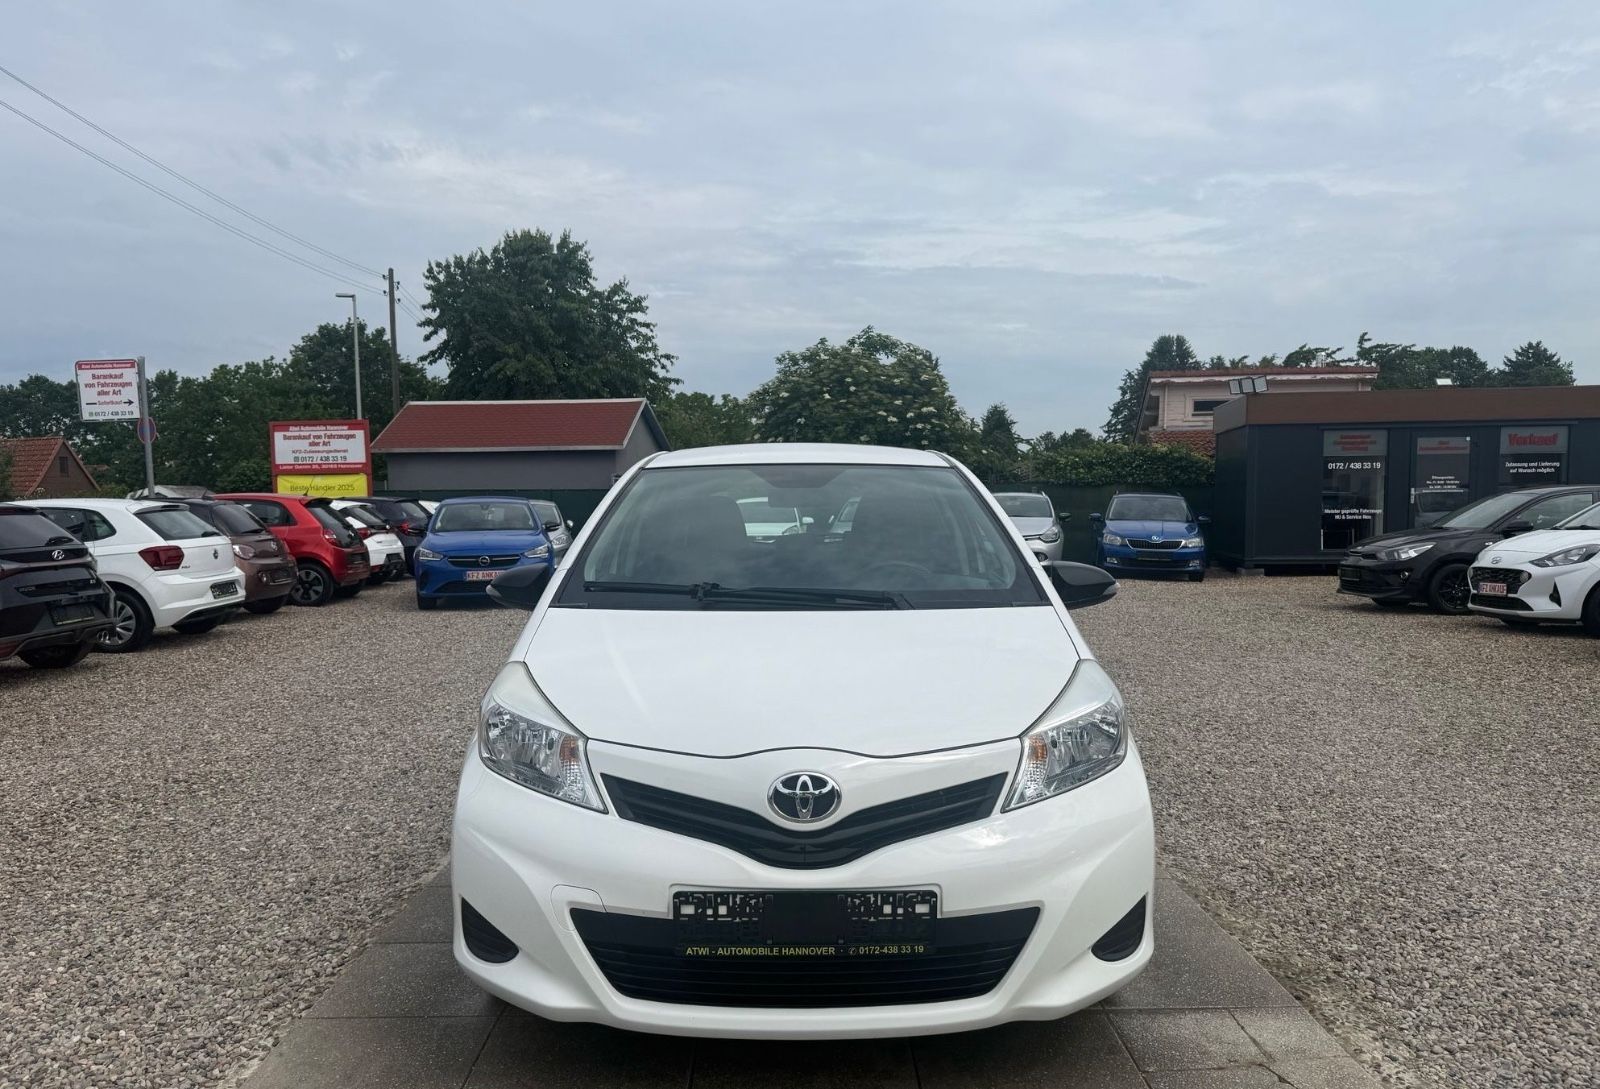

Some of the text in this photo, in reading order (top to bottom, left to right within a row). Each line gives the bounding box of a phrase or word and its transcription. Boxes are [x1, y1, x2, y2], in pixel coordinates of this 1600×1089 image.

[686, 947, 710, 956] ATWI
[717, 947, 780, 956] AUTOMOBILE
[782, 947, 836, 956] HANNOVER
[859, 946, 898, 954] 0172-438
[914, 945, 924, 954] 19
